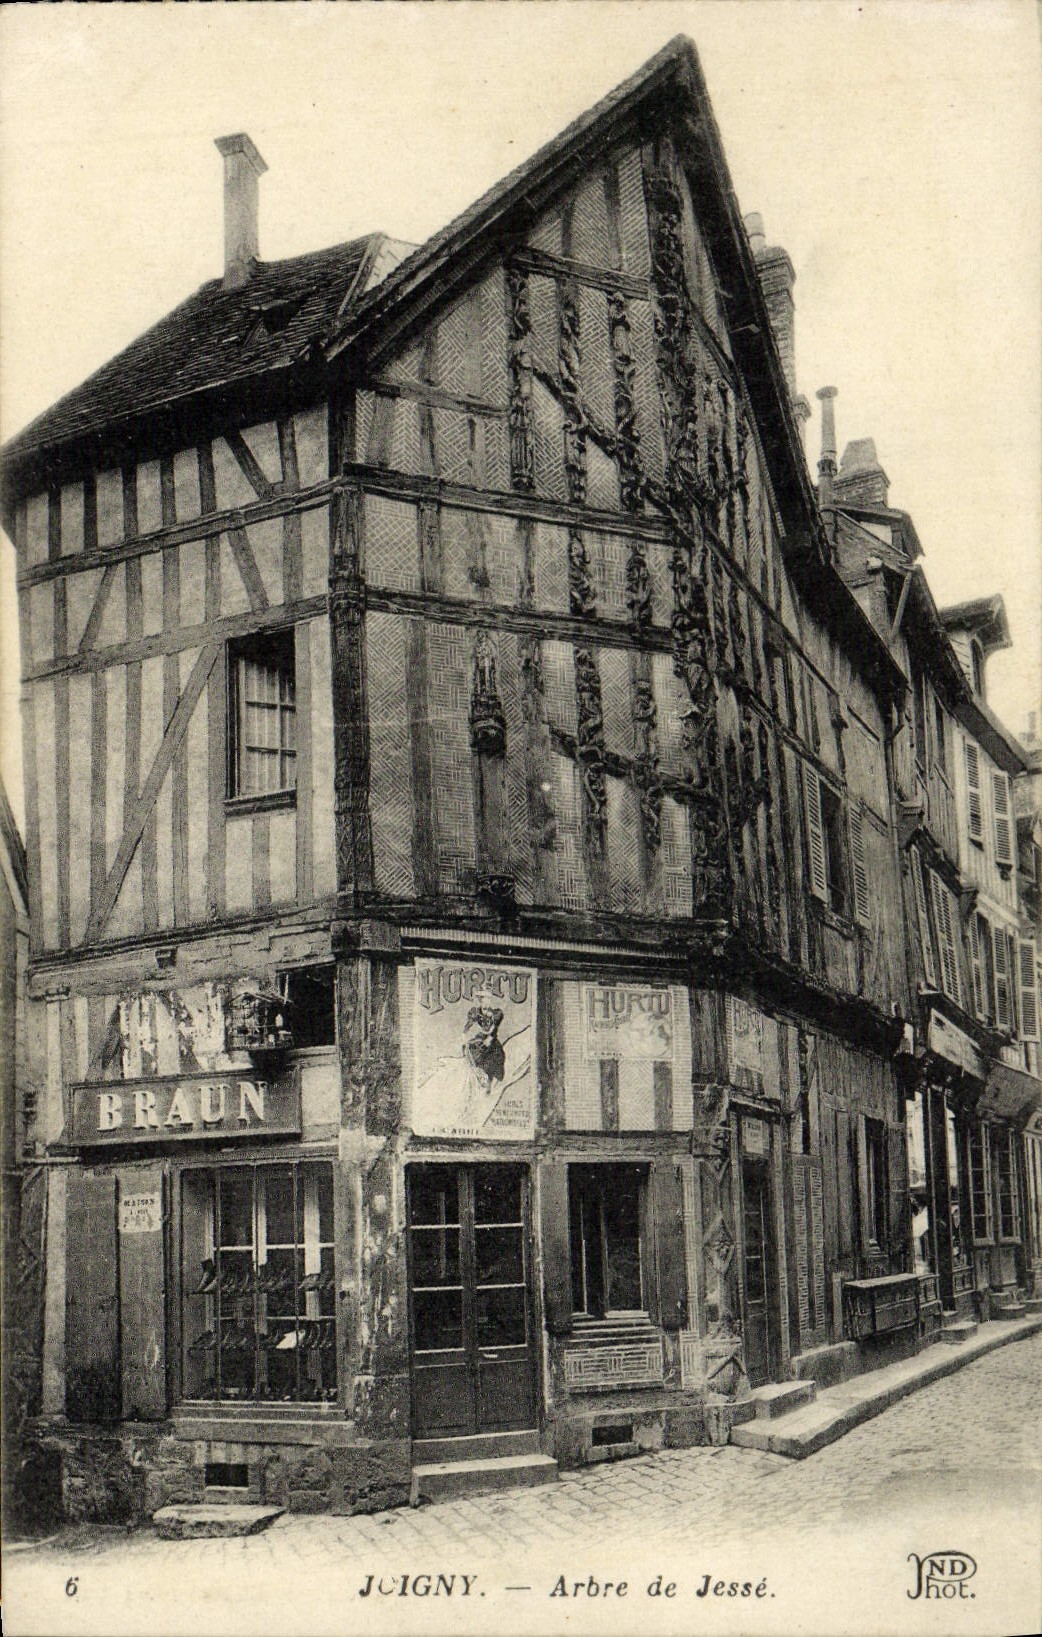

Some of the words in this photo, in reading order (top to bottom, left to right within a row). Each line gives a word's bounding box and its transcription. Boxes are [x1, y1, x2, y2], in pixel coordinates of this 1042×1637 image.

[419, 966, 532, 1015] HURTU
[588, 990, 671, 1018] HURTU
[96, 1081, 267, 1131] BRAUN
